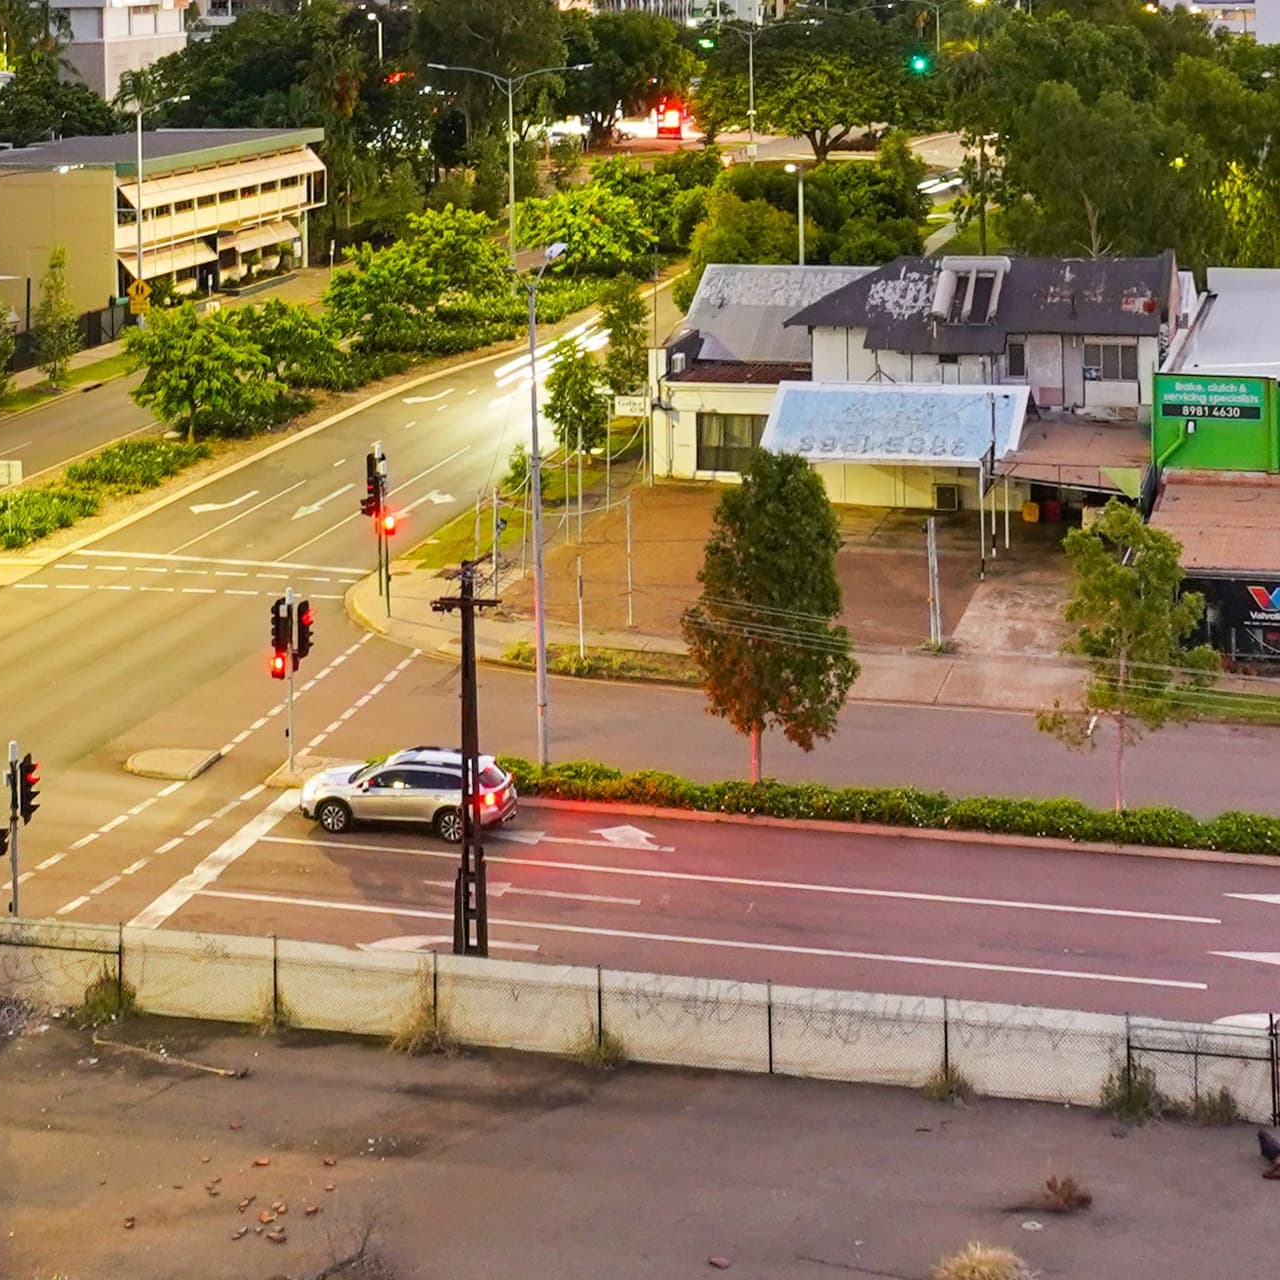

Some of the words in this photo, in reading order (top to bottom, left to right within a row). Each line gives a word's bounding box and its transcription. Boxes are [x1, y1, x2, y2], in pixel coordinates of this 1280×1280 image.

[1174, 382, 1206, 393] Brake,
[1207, 383, 1237, 393] clutch
[1239, 384, 1247, 393] &
[1163, 393, 1207, 405] servicing
[1209, 394, 1259, 405] specialists
[1182, 406, 1209, 416] 8981
[1212, 407, 1241, 417] 4630
